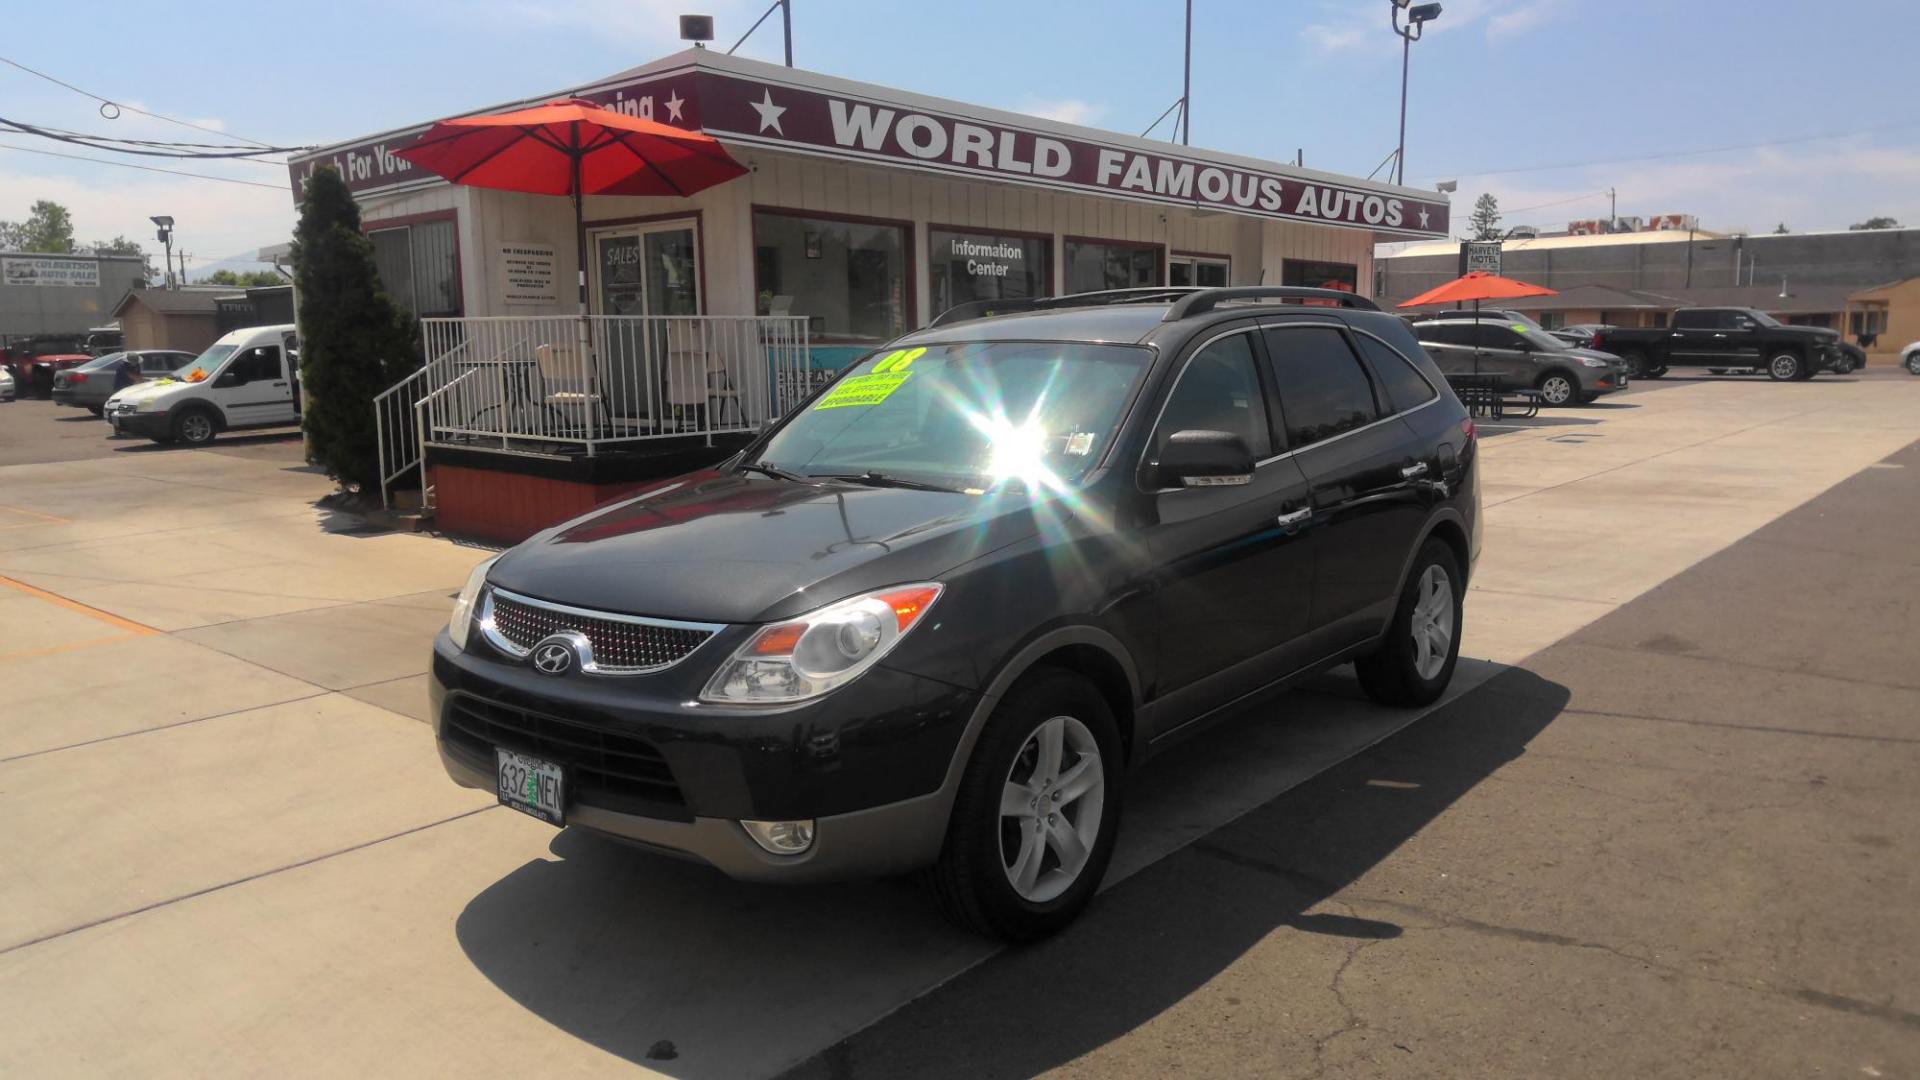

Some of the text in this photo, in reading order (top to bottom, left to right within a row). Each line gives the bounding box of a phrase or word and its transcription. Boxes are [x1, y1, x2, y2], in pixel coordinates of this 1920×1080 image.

[347, 152, 371, 181] For
[828, 99, 1404, 227] WORLD FAMOUS AUTOS
[607, 246, 639, 266] SALES
[952, 239, 1022, 259] Information
[967, 259, 1009, 277] Center
[1470, 255, 1498, 264] MOTEL
[500, 762, 562, 812] 632 NEN
